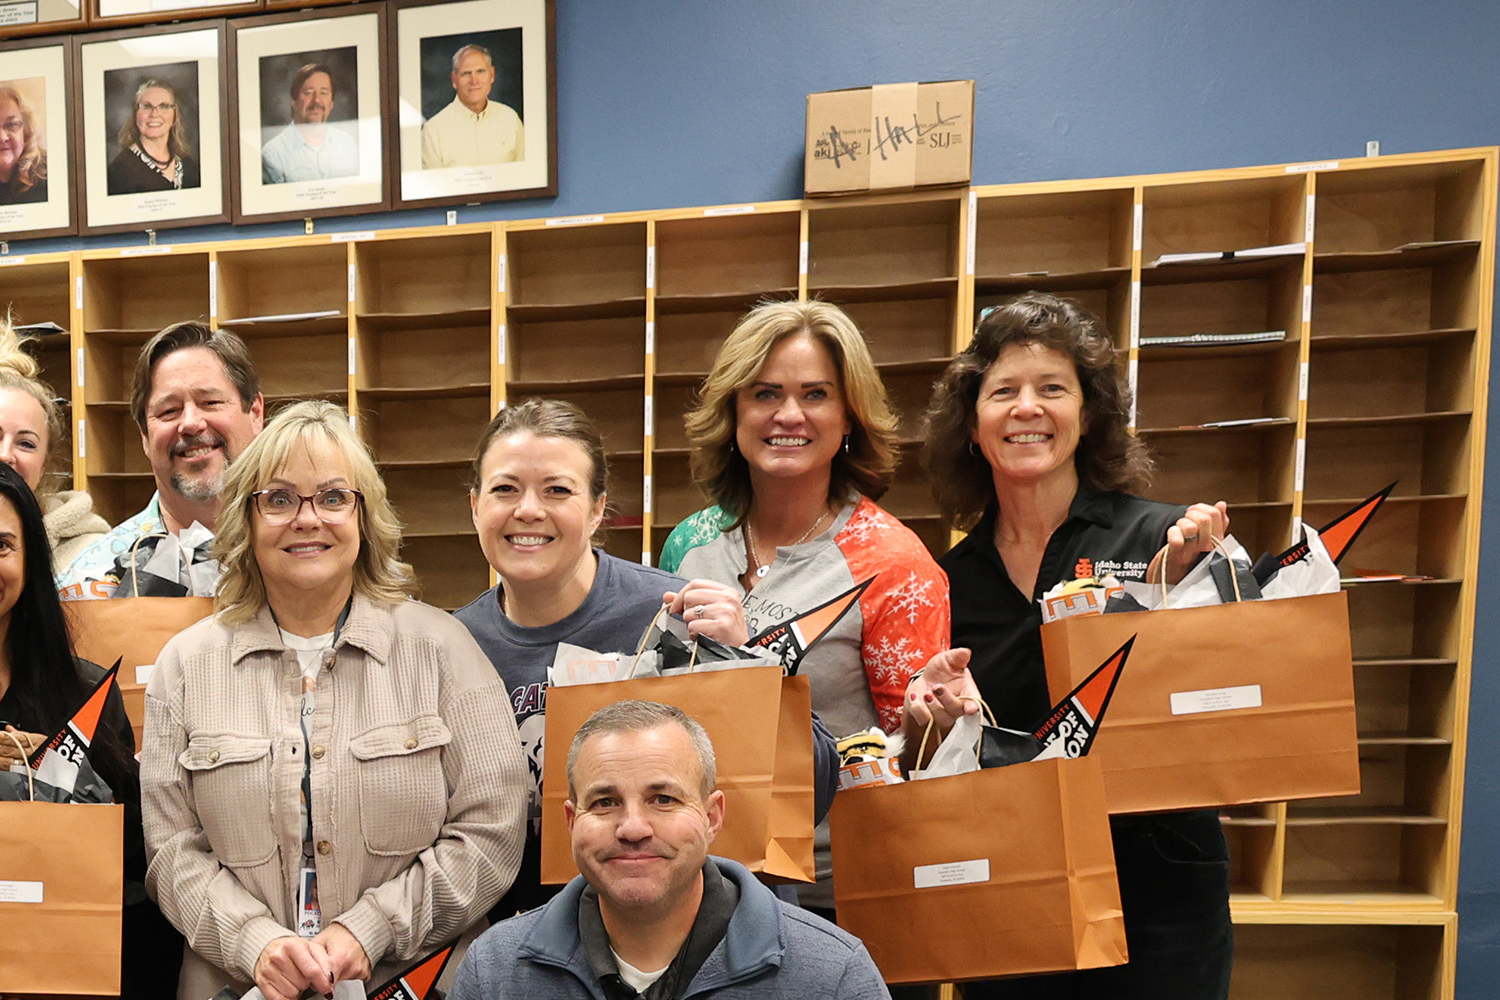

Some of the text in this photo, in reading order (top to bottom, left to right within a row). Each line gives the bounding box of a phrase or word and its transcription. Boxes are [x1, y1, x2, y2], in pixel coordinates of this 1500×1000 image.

[929, 132, 950, 148] SLJ
[1094, 560, 1148, 569] Idaho State
[57, 734, 76, 761] OF
